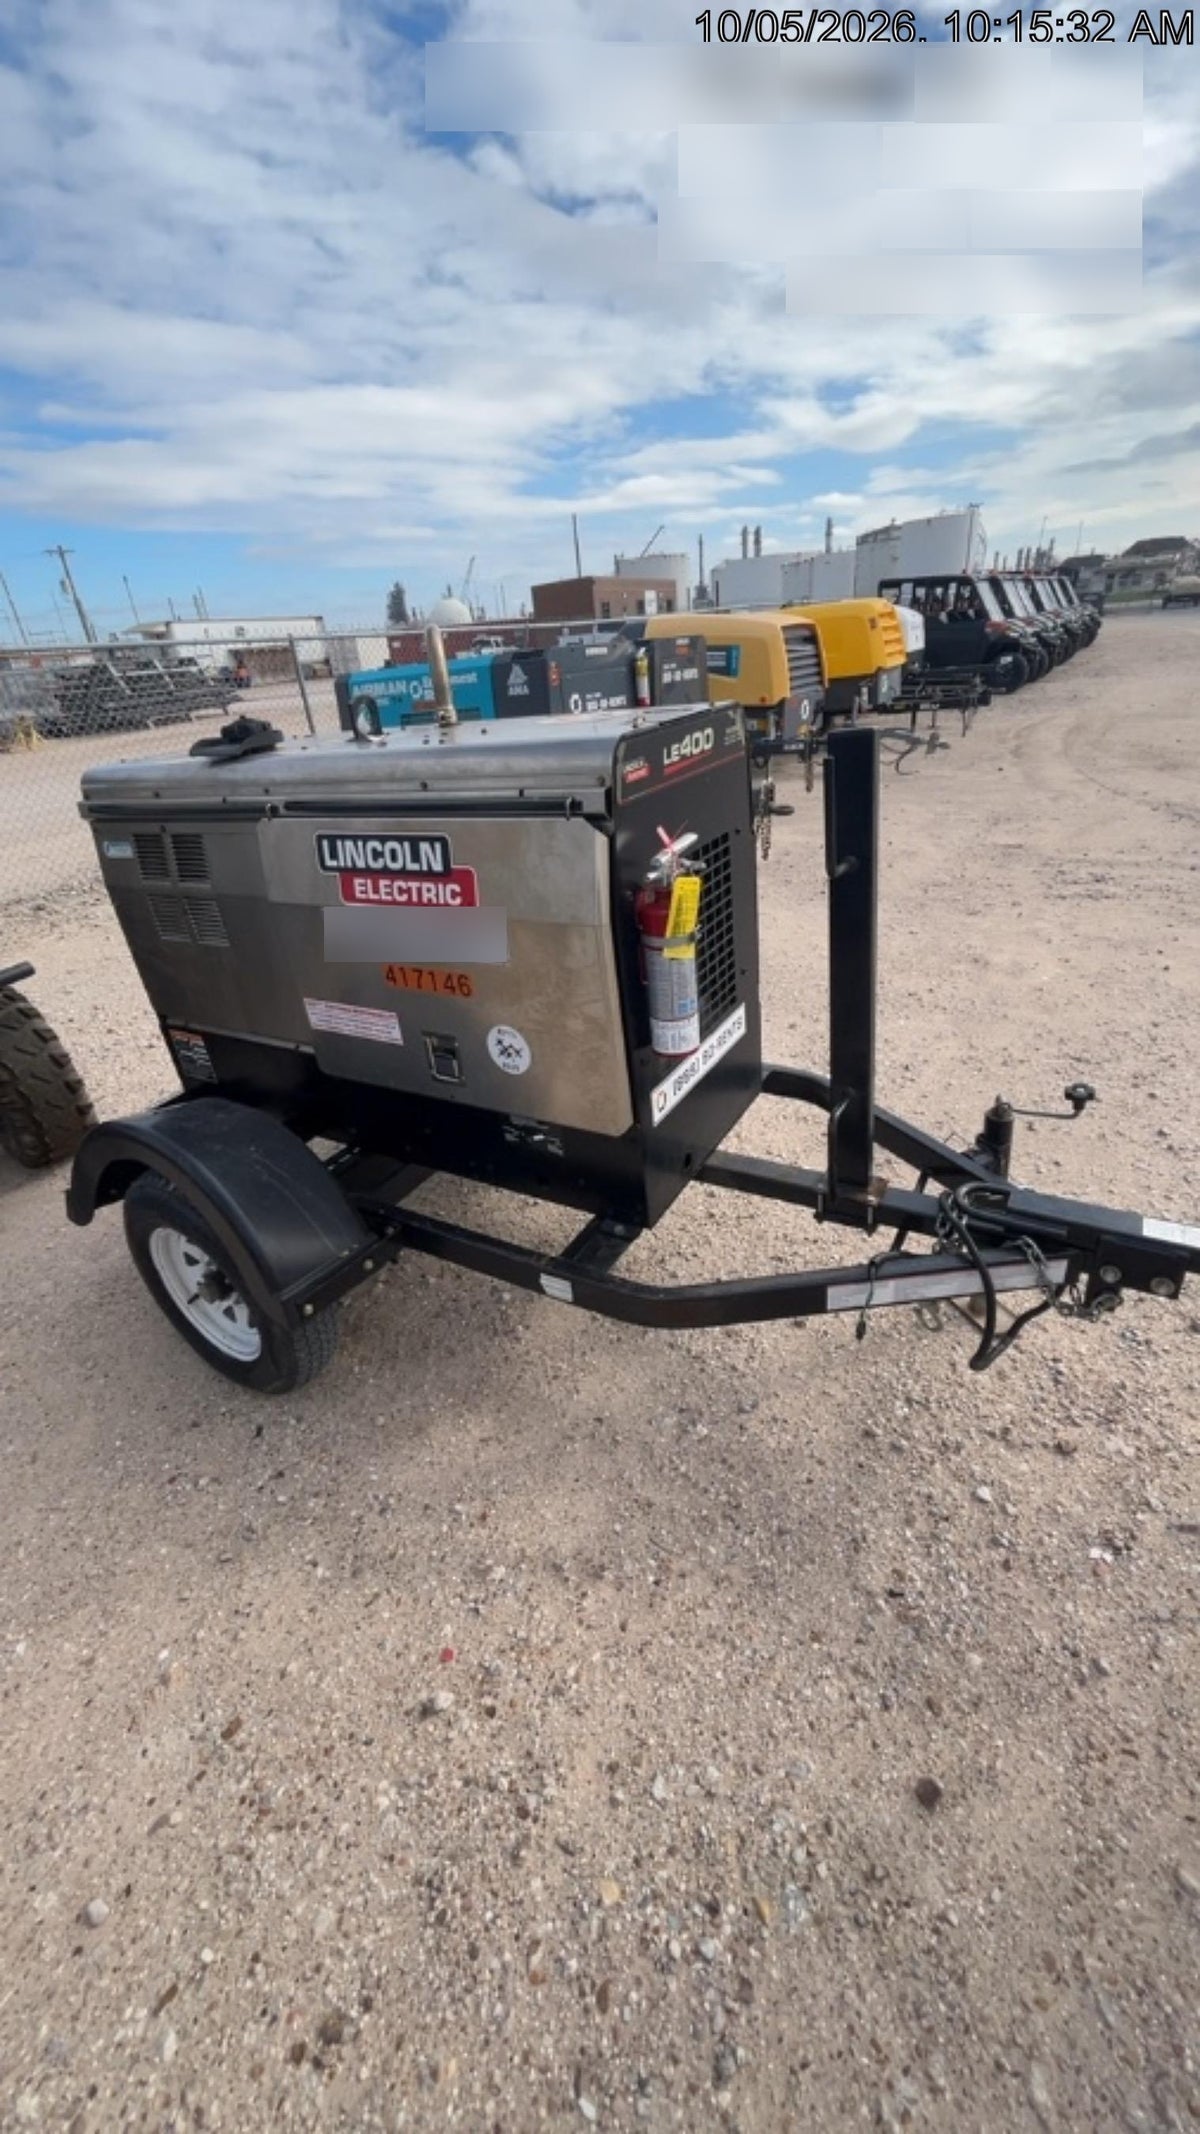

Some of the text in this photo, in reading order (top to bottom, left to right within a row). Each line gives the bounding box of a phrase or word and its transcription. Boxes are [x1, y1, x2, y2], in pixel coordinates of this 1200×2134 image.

[663, 727, 714, 765] LE400
[321, 838, 444, 873] LINCOLN
[353, 878, 462, 907] ELECTRIC
[384, 965, 473, 998] 417146
